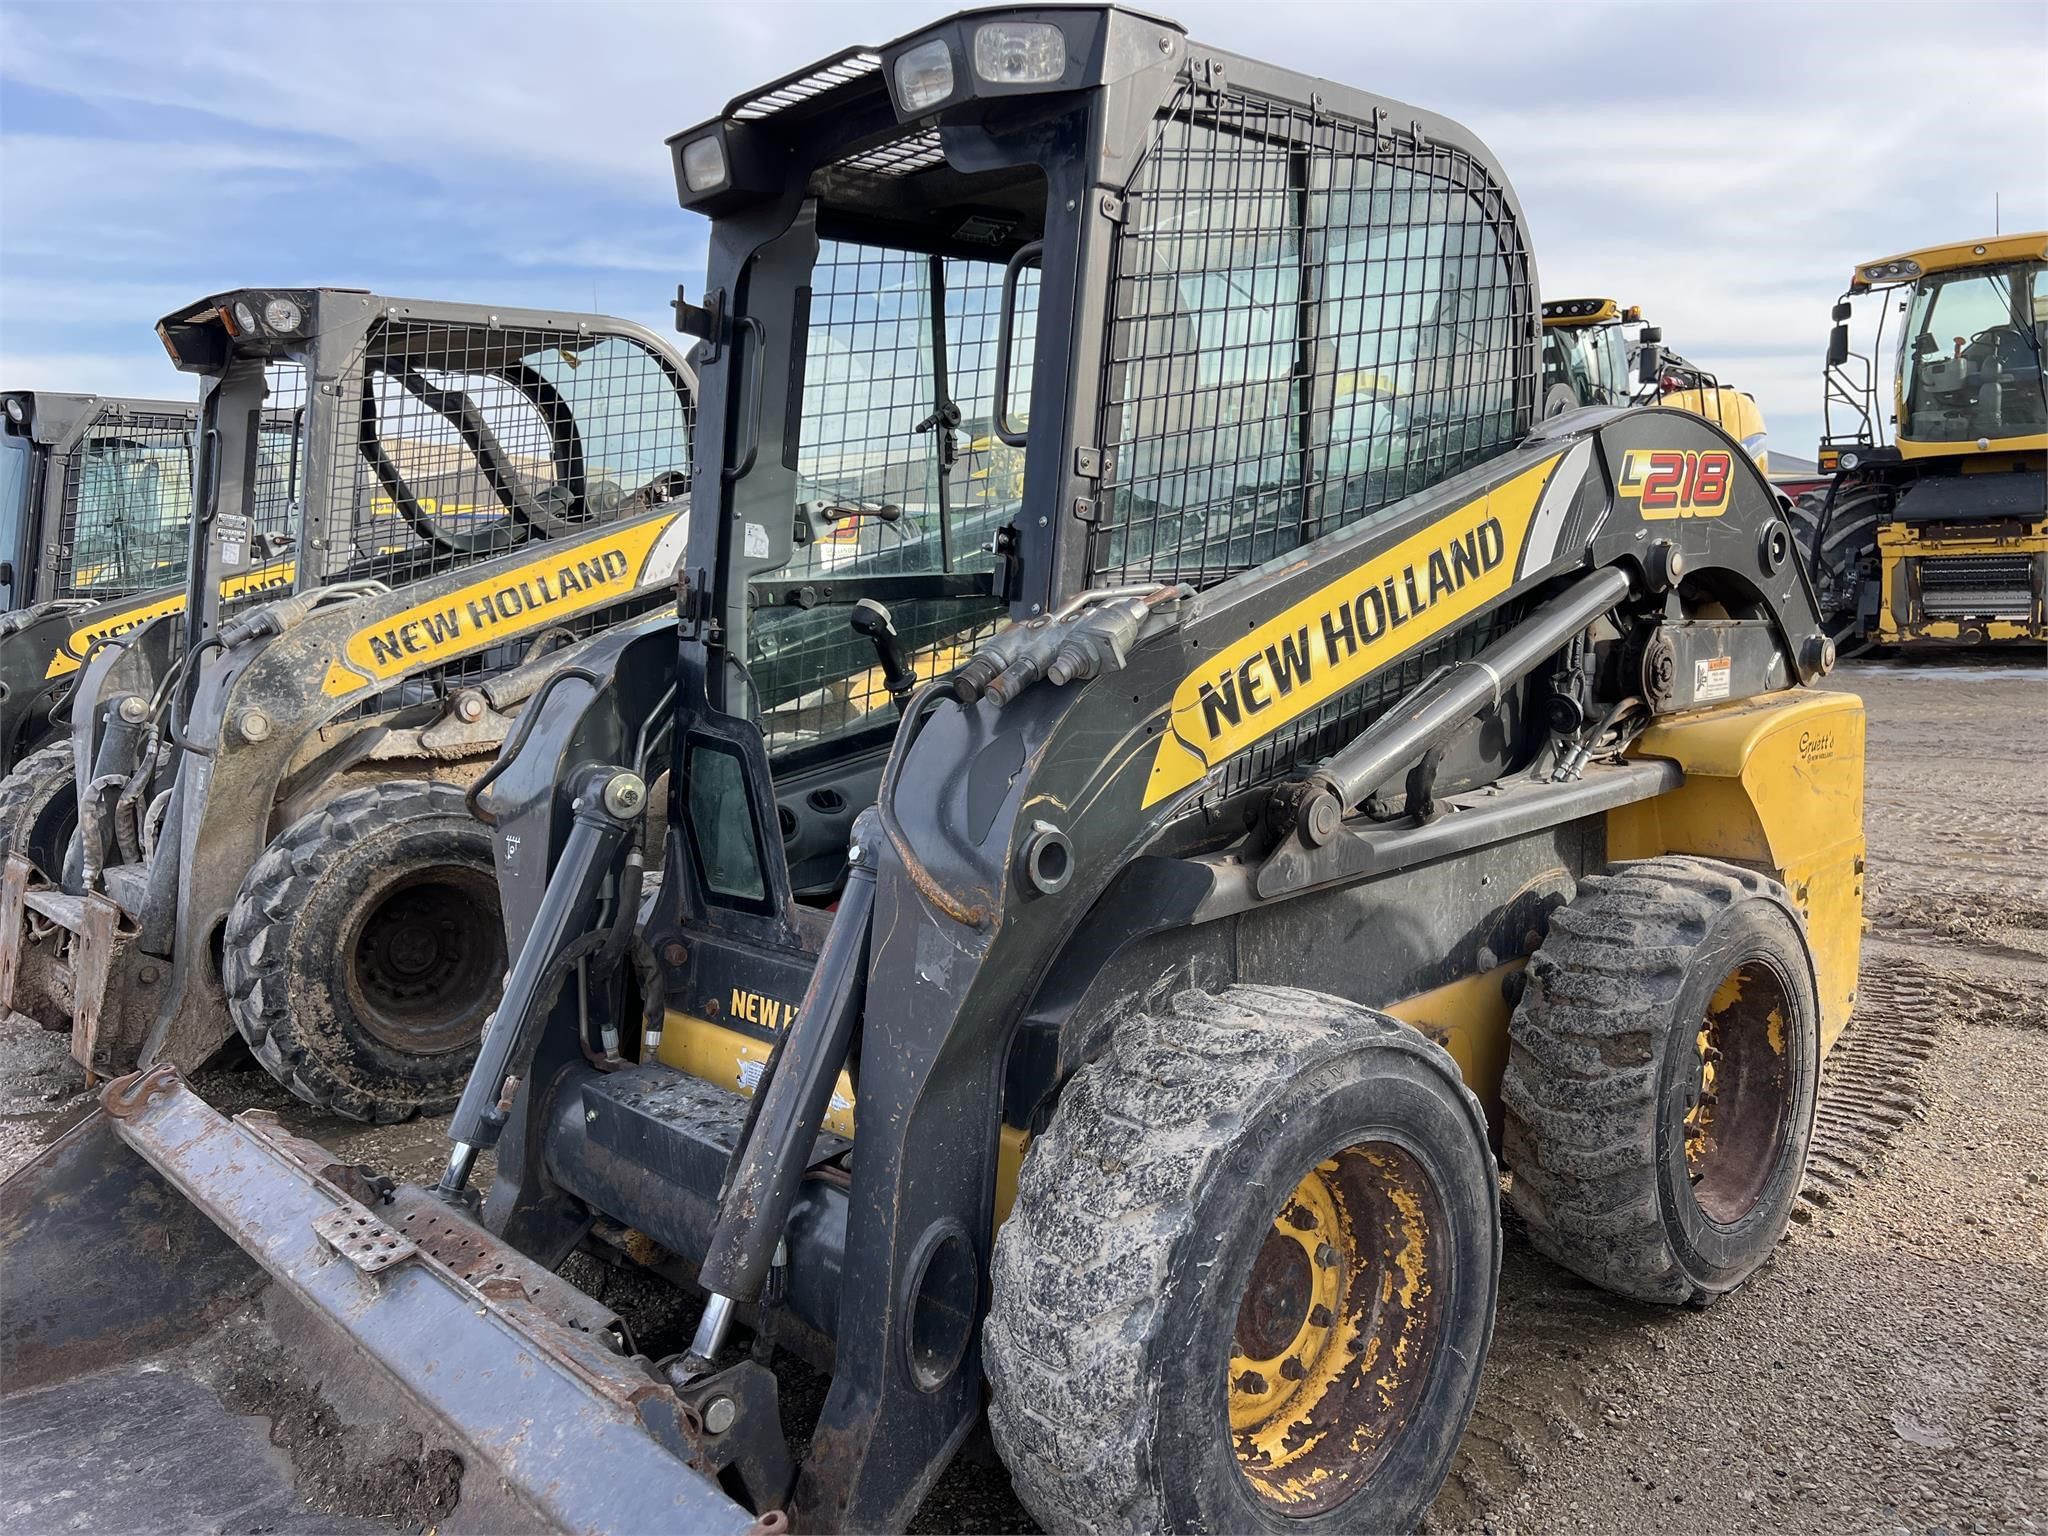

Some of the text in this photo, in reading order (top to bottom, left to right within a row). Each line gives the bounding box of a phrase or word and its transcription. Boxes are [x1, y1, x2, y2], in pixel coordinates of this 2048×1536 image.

[1619, 451, 1733, 516] L218
[367, 549, 628, 666] NEW HOLLAND
[1198, 516, 1505, 741] NEW HOLLAND
[730, 987, 780, 1030] NEW
